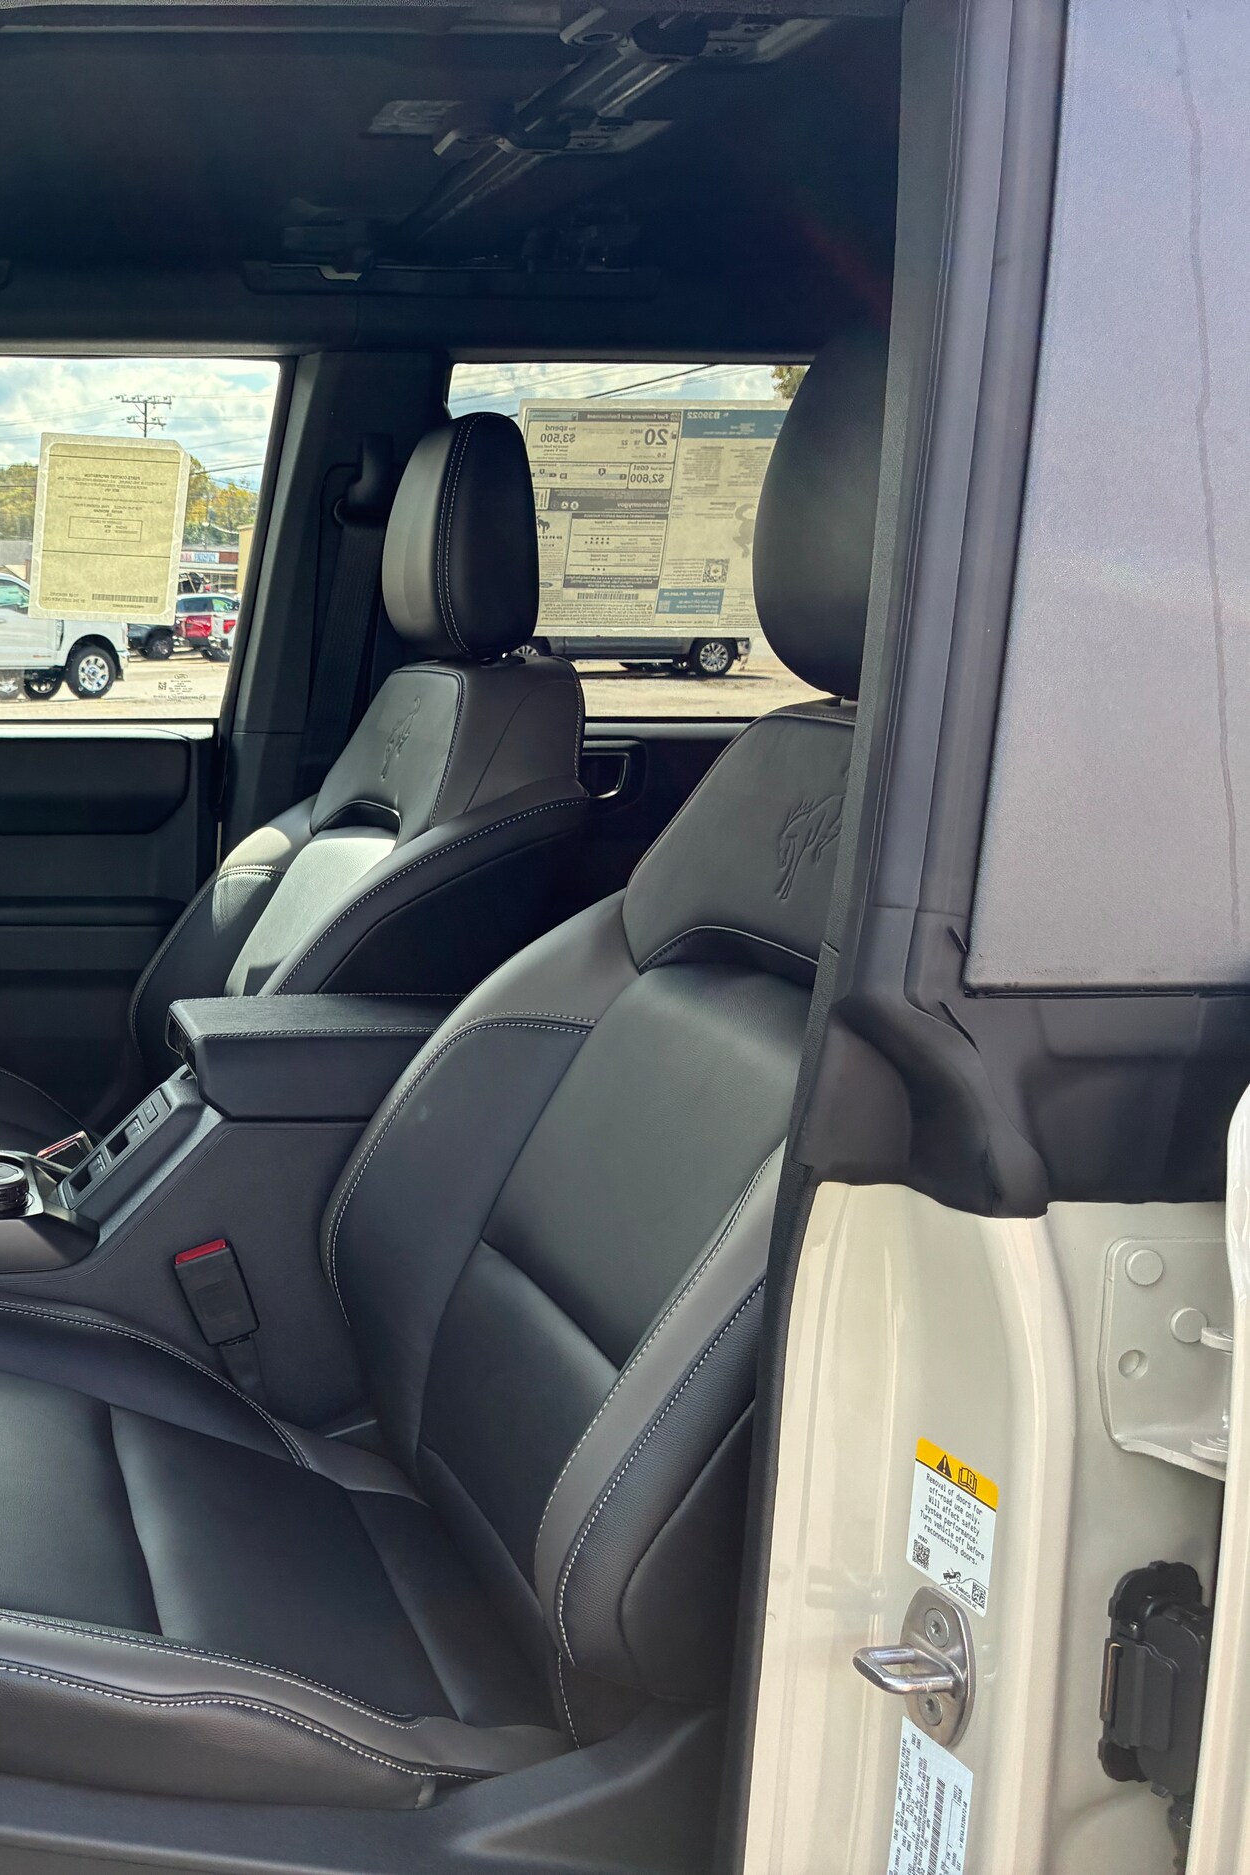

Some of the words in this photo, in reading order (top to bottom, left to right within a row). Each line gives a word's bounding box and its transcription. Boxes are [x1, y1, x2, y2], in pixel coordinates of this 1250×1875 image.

[926, 1473, 946, 1492] Removal
[956, 1494, 971, 1508] doors
[974, 1505, 983, 1515] for
[929, 1487, 953, 1506] off-road
[954, 1504, 963, 1514] use
[965, 1511, 980, 1525] only.
[920, 1510, 932, 1523] Turn
[934, 1520, 954, 1538] vehicle
[955, 1535, 965, 1545] off
[967, 1542, 985, 1561] before
[925, 1504, 942, 1519] system
[944, 1517, 978, 1544] performance.
[928, 1495, 940, 1509] Will
[942, 1505, 960, 1521] affect
[962, 1519, 980, 1537] safety
[924, 1524, 959, 1554] reconnecting
[960, 1549, 978, 1565] doors.
